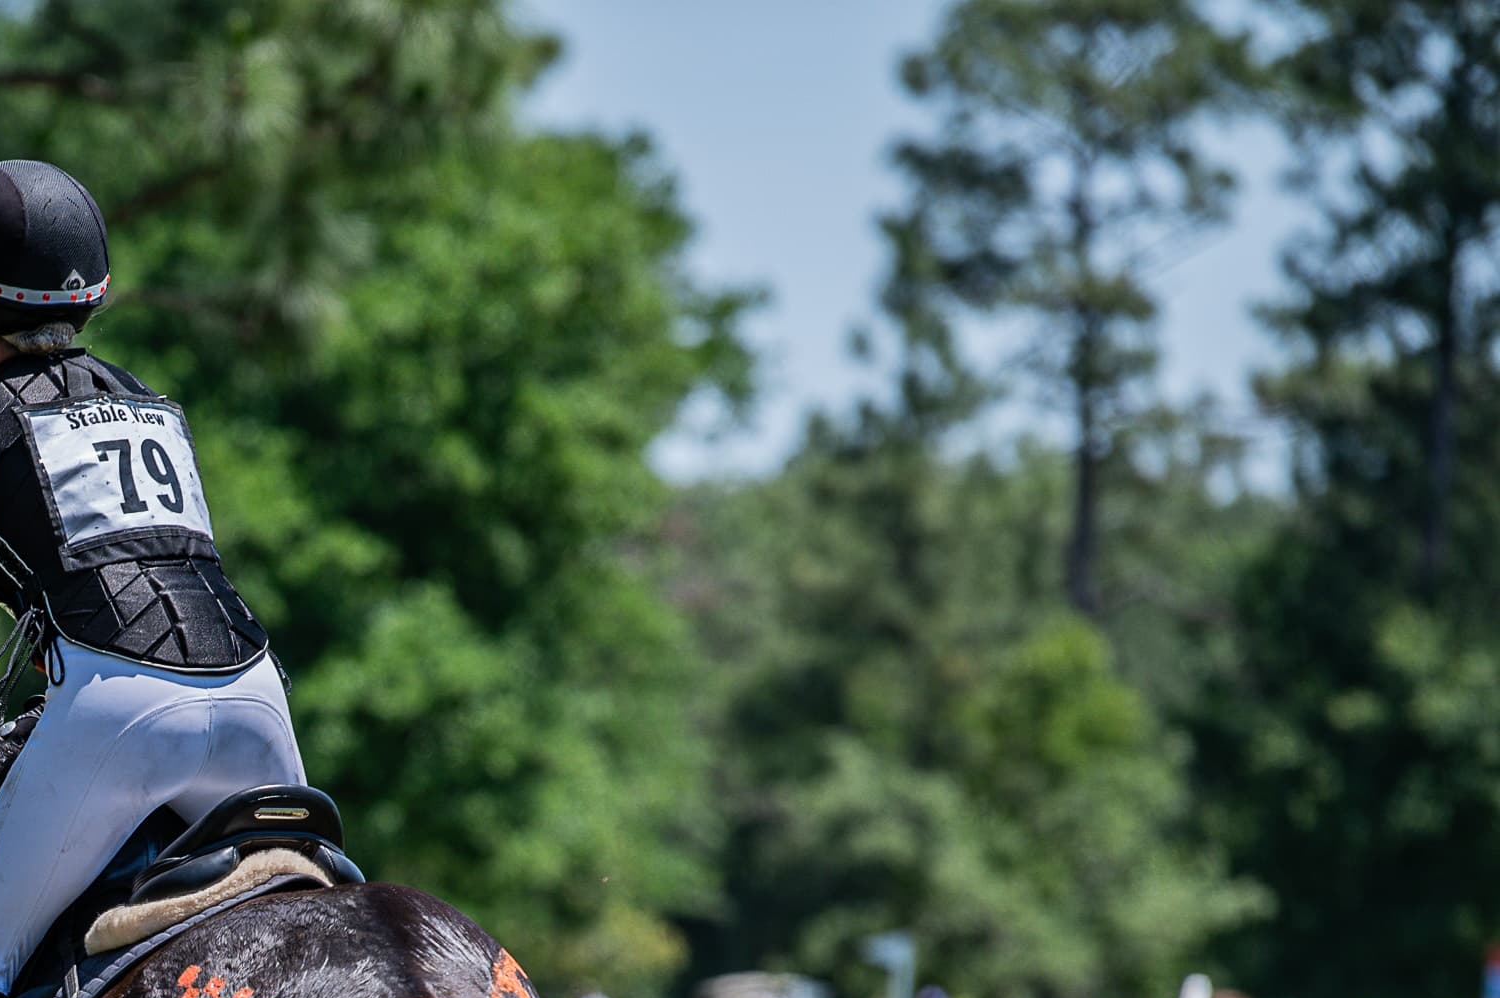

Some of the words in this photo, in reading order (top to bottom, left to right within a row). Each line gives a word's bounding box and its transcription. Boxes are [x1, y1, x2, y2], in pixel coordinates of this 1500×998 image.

[66, 405, 127, 430] Stable
[129, 405, 165, 426] View
[92, 439, 184, 514] 79
